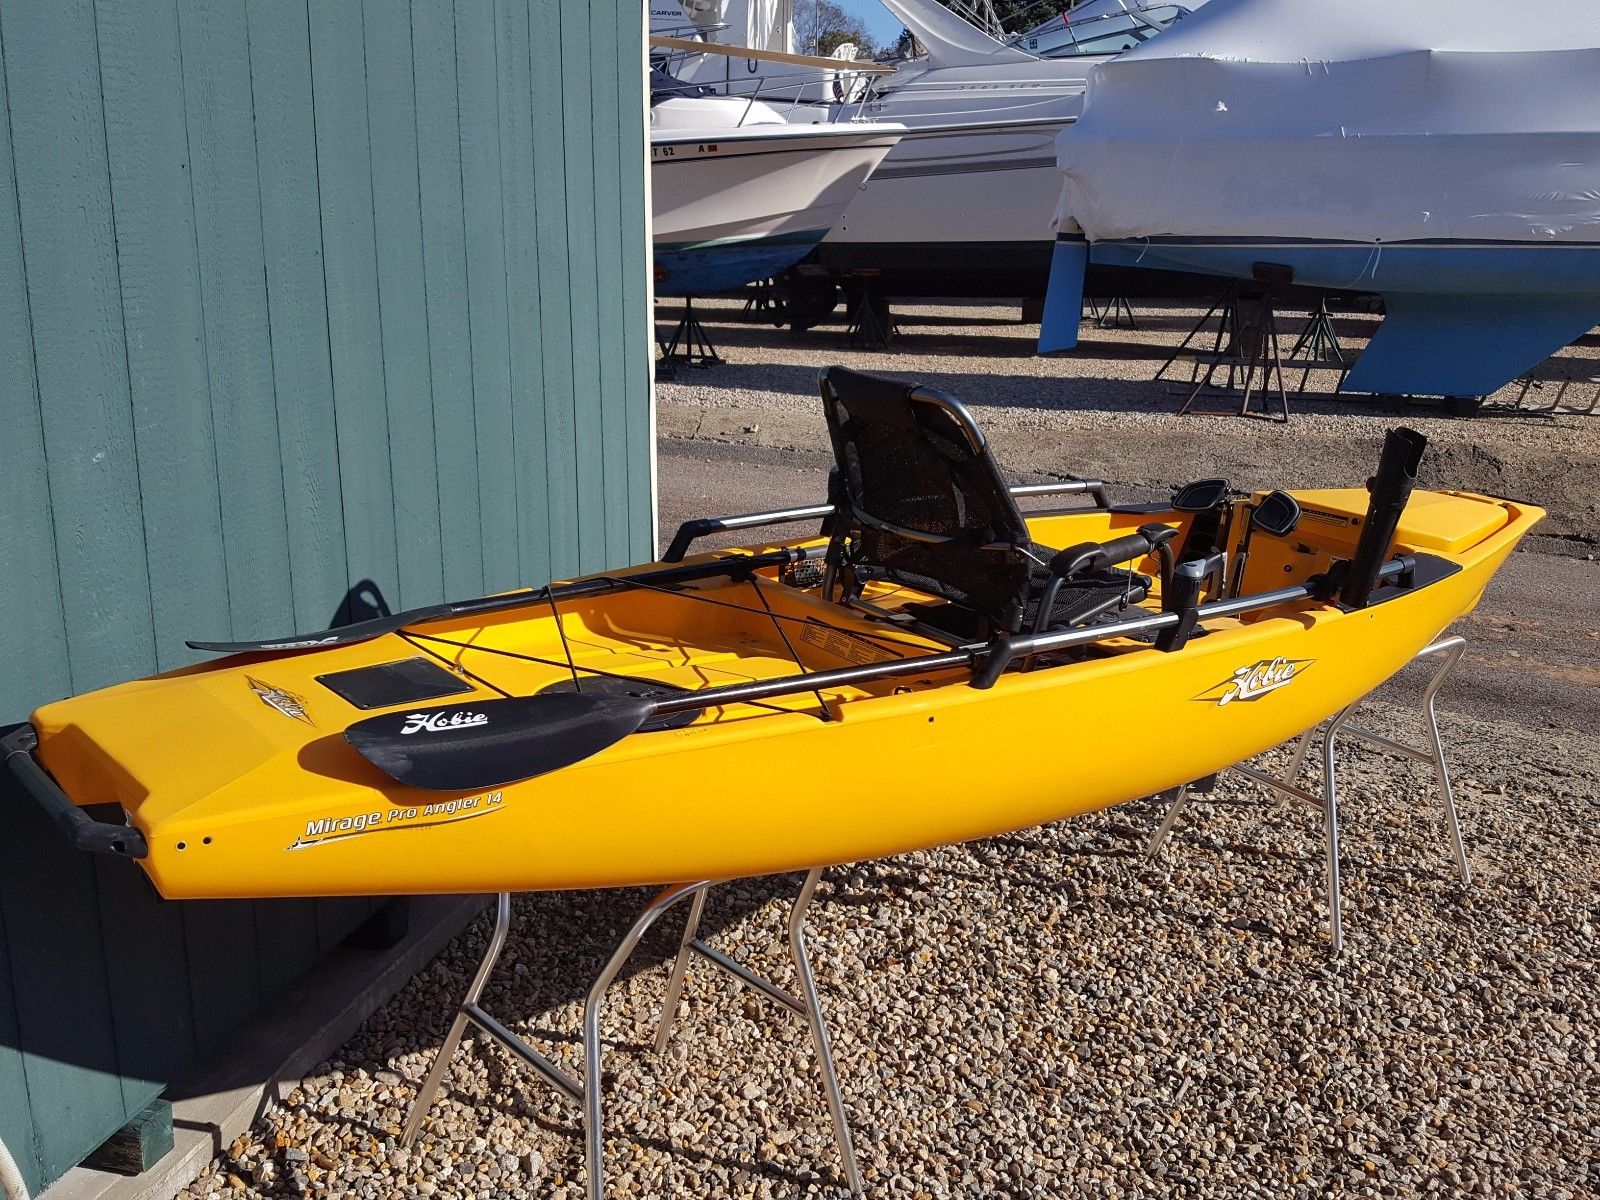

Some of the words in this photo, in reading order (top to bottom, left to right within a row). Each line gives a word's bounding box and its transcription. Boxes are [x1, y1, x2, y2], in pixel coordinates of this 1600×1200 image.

[662, 146, 676, 156] 62
[698, 144, 705, 153] A
[1217, 656, 1296, 706] Hobie
[400, 711, 488, 735] Hobie
[305, 811, 382, 836] Mirage
[386, 806, 418, 823] Pro
[423, 796, 481, 817] Angler
[486, 791, 503, 805] 14
